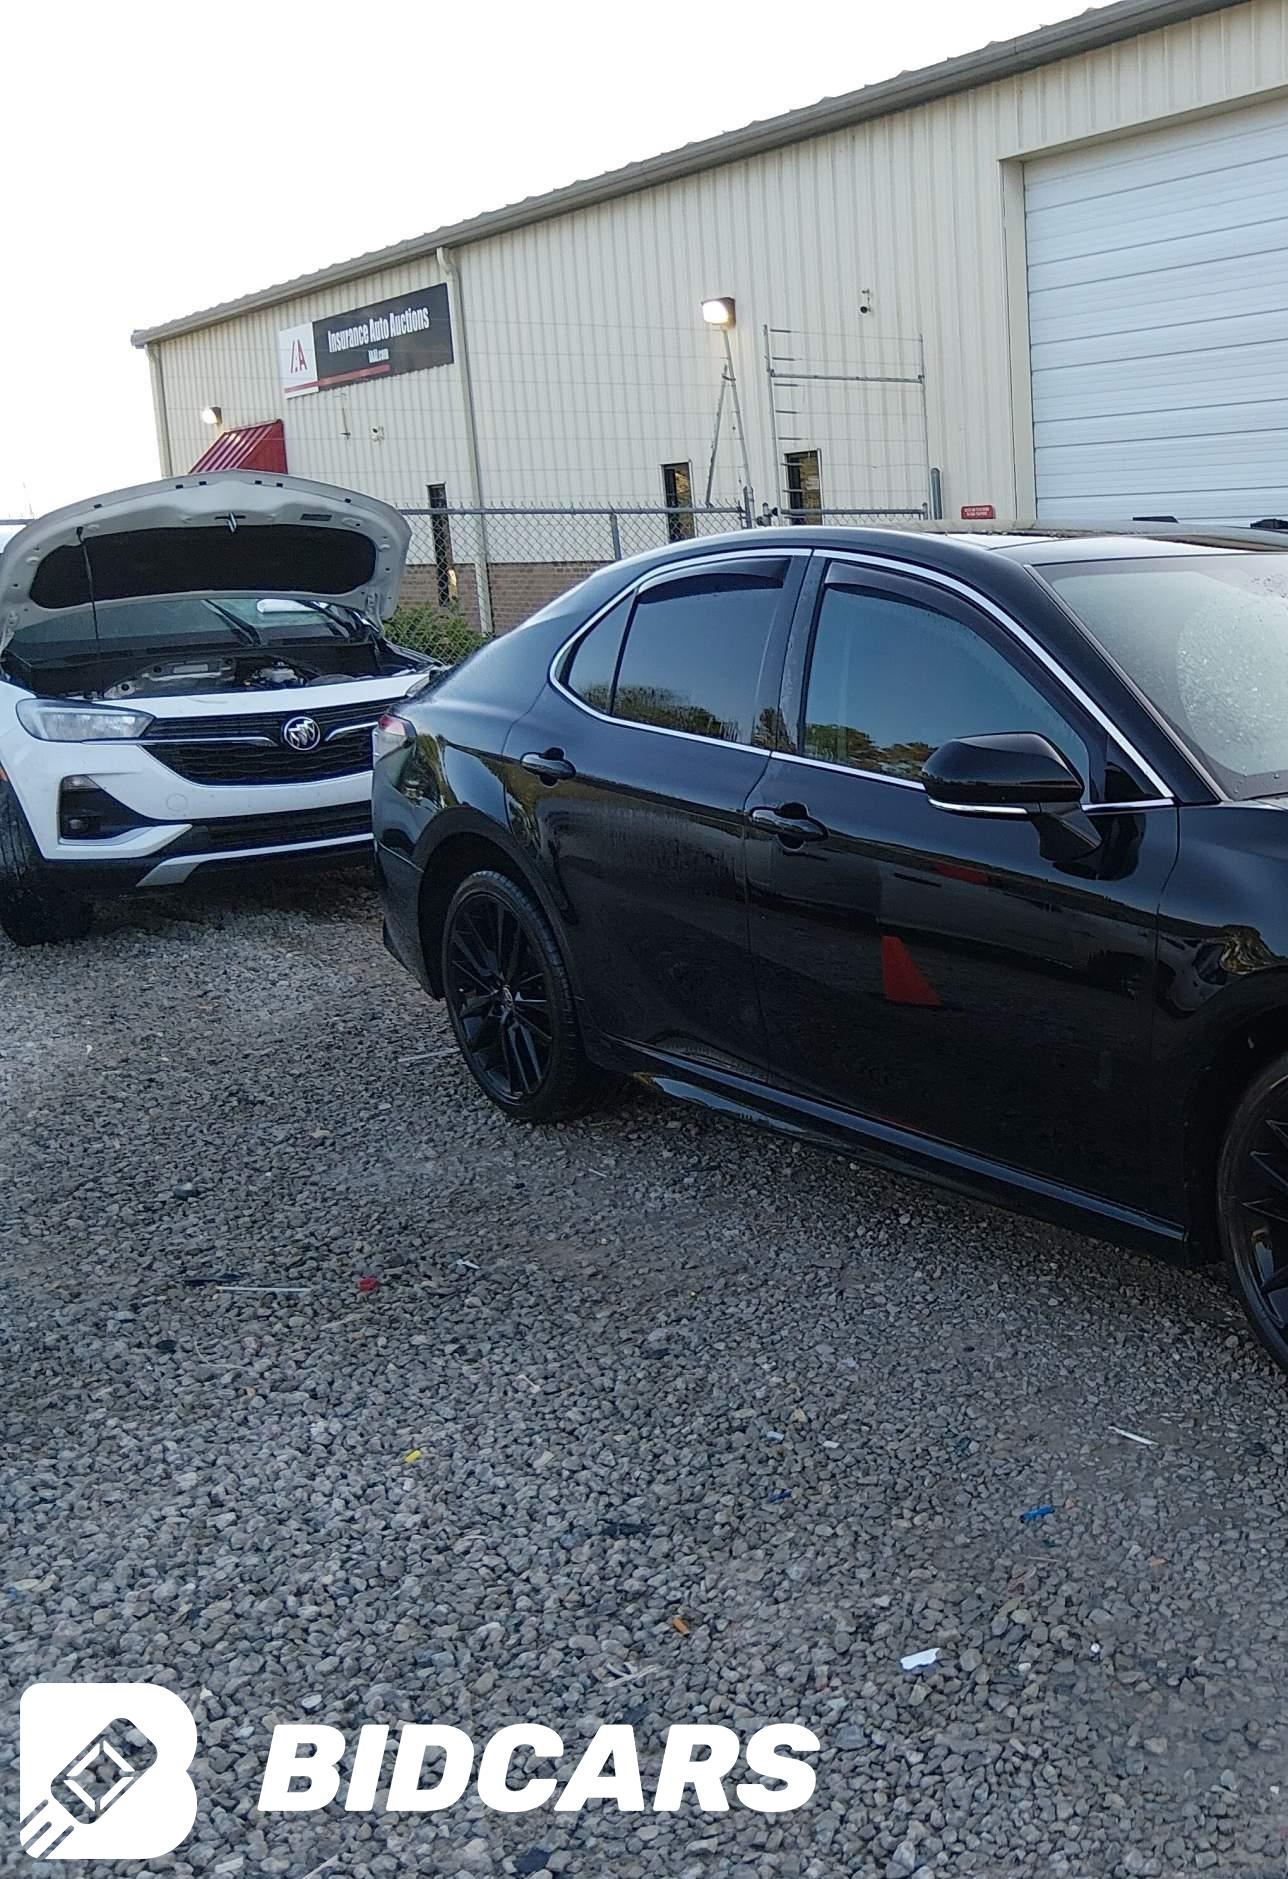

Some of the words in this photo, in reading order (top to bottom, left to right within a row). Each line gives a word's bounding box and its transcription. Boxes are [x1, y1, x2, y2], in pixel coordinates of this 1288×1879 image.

[328, 326, 369, 353] Insurance
[369, 317, 390, 343] Auto
[389, 307, 430, 338] Auctions
